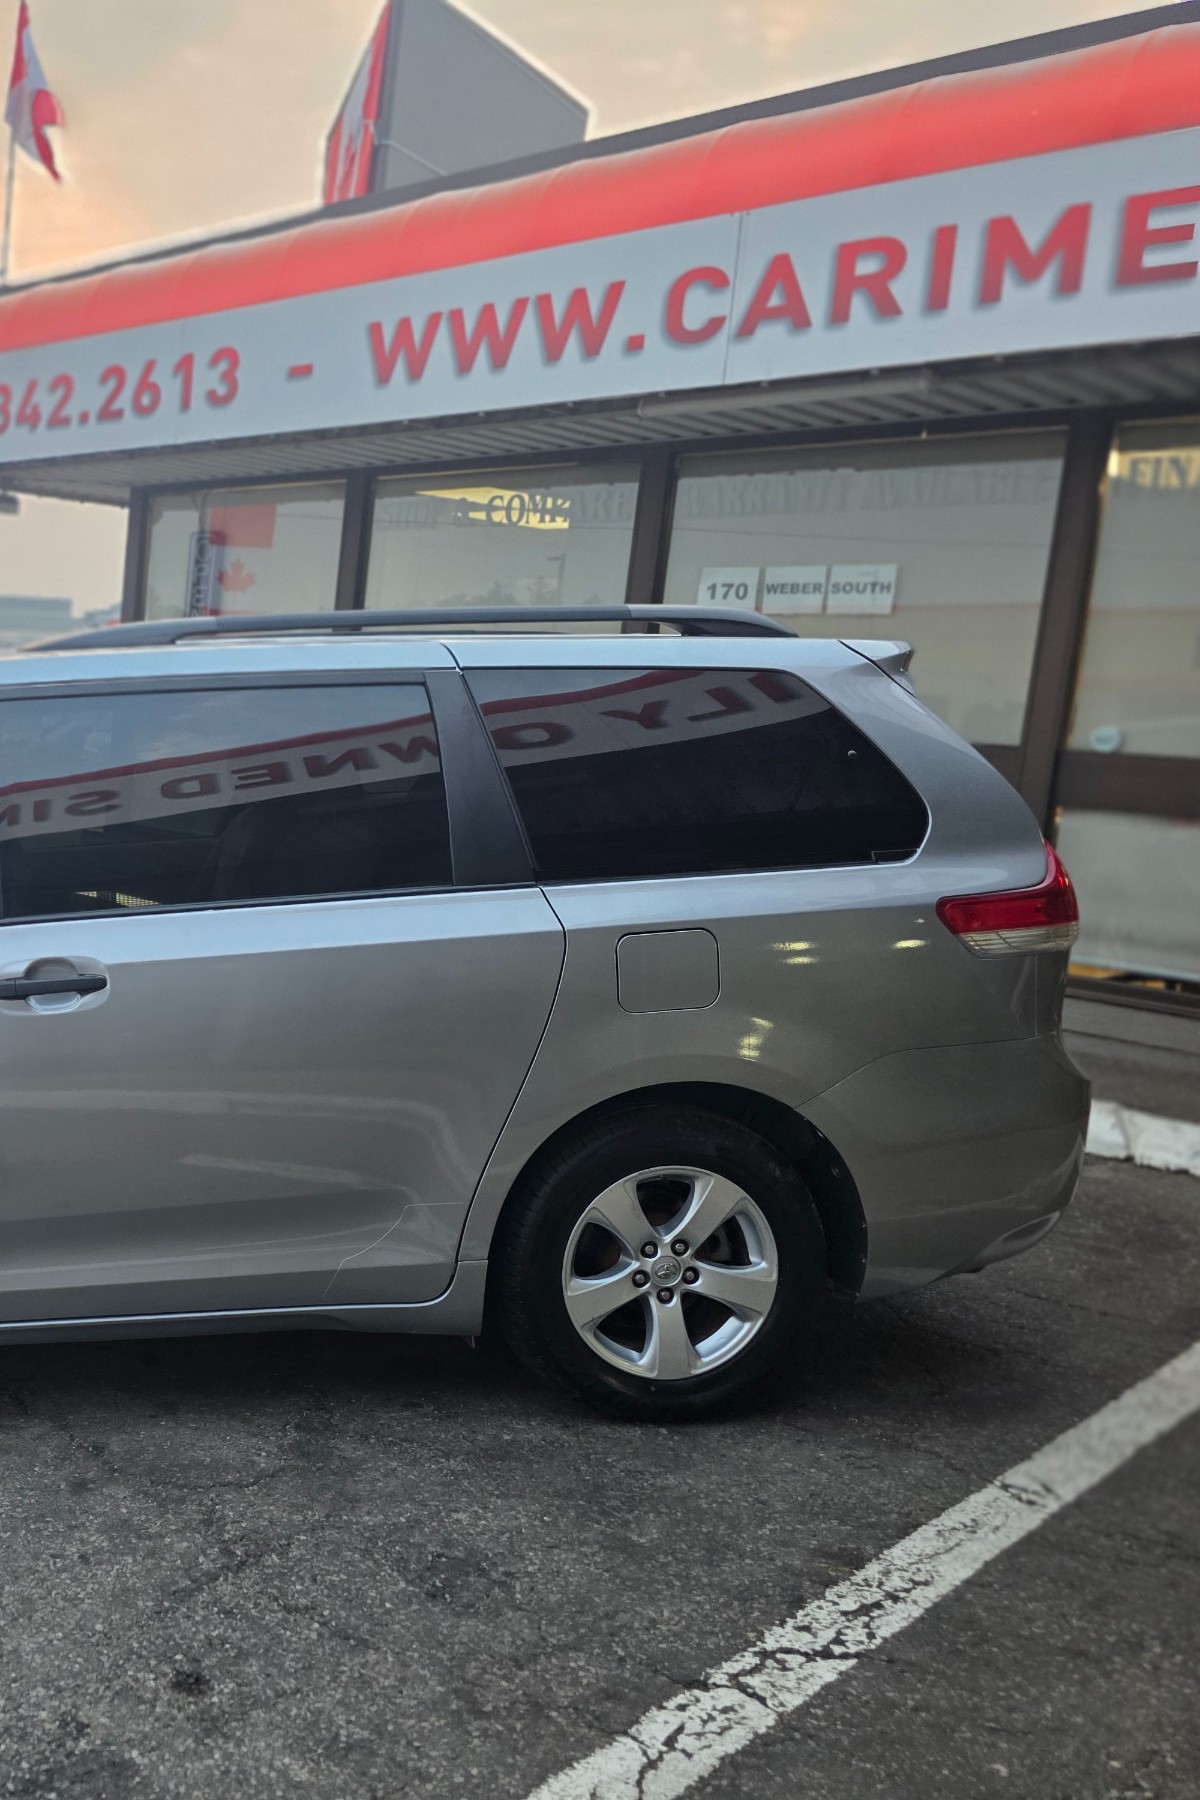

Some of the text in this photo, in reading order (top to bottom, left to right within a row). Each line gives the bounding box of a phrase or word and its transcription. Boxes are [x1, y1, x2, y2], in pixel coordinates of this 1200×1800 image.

[705, 580, 893, 601] 170 WEBER SOUTH
